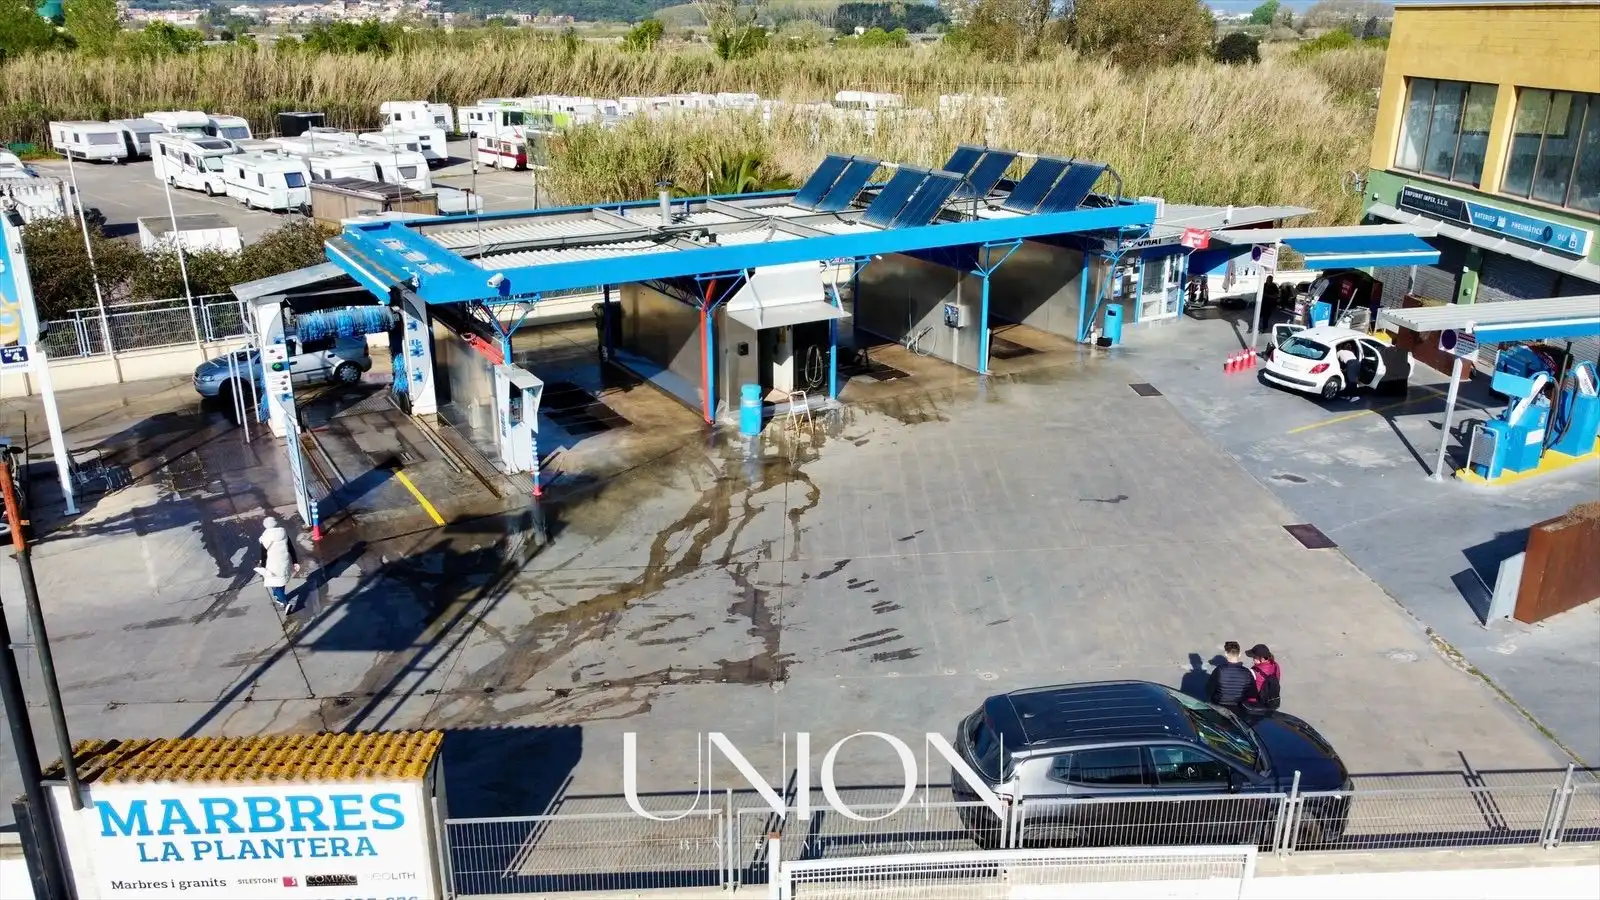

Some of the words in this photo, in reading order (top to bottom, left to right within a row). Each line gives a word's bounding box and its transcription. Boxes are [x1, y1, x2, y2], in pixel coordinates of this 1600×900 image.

[1474, 211, 1496, 223] BATERIES
[1557, 233, 1567, 242] OLI
[94, 793, 405, 837] MARBRES
[138, 841, 184, 862] LA
[192, 836, 378, 861] PLANTERA
[111, 880, 168, 889] Marbres
[171, 879, 175, 888] i
[179, 878, 227, 890] granits
[306, 875, 357, 883] COMPAC
